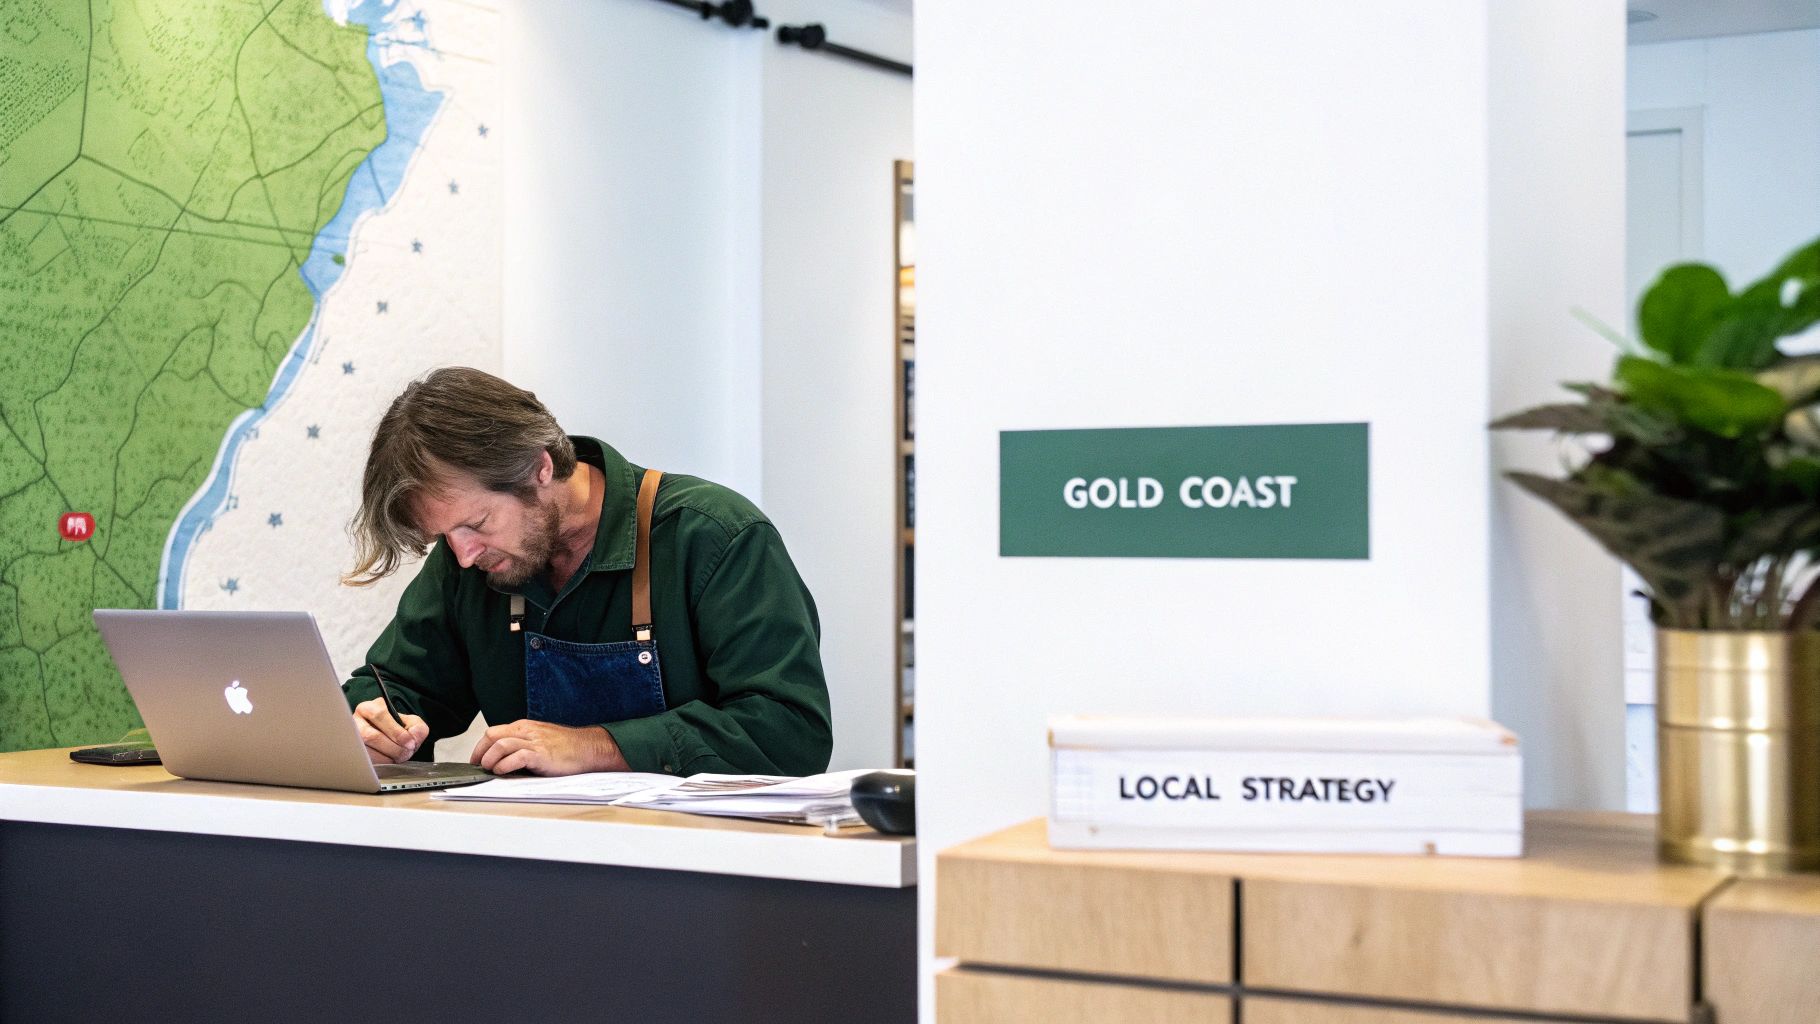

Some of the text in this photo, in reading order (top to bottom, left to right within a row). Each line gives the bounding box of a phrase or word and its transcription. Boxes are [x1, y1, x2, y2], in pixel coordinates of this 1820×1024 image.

[1063, 475, 1298, 509] GOLD COAST
[1120, 776, 1395, 803] LOCAL STRATEGY
